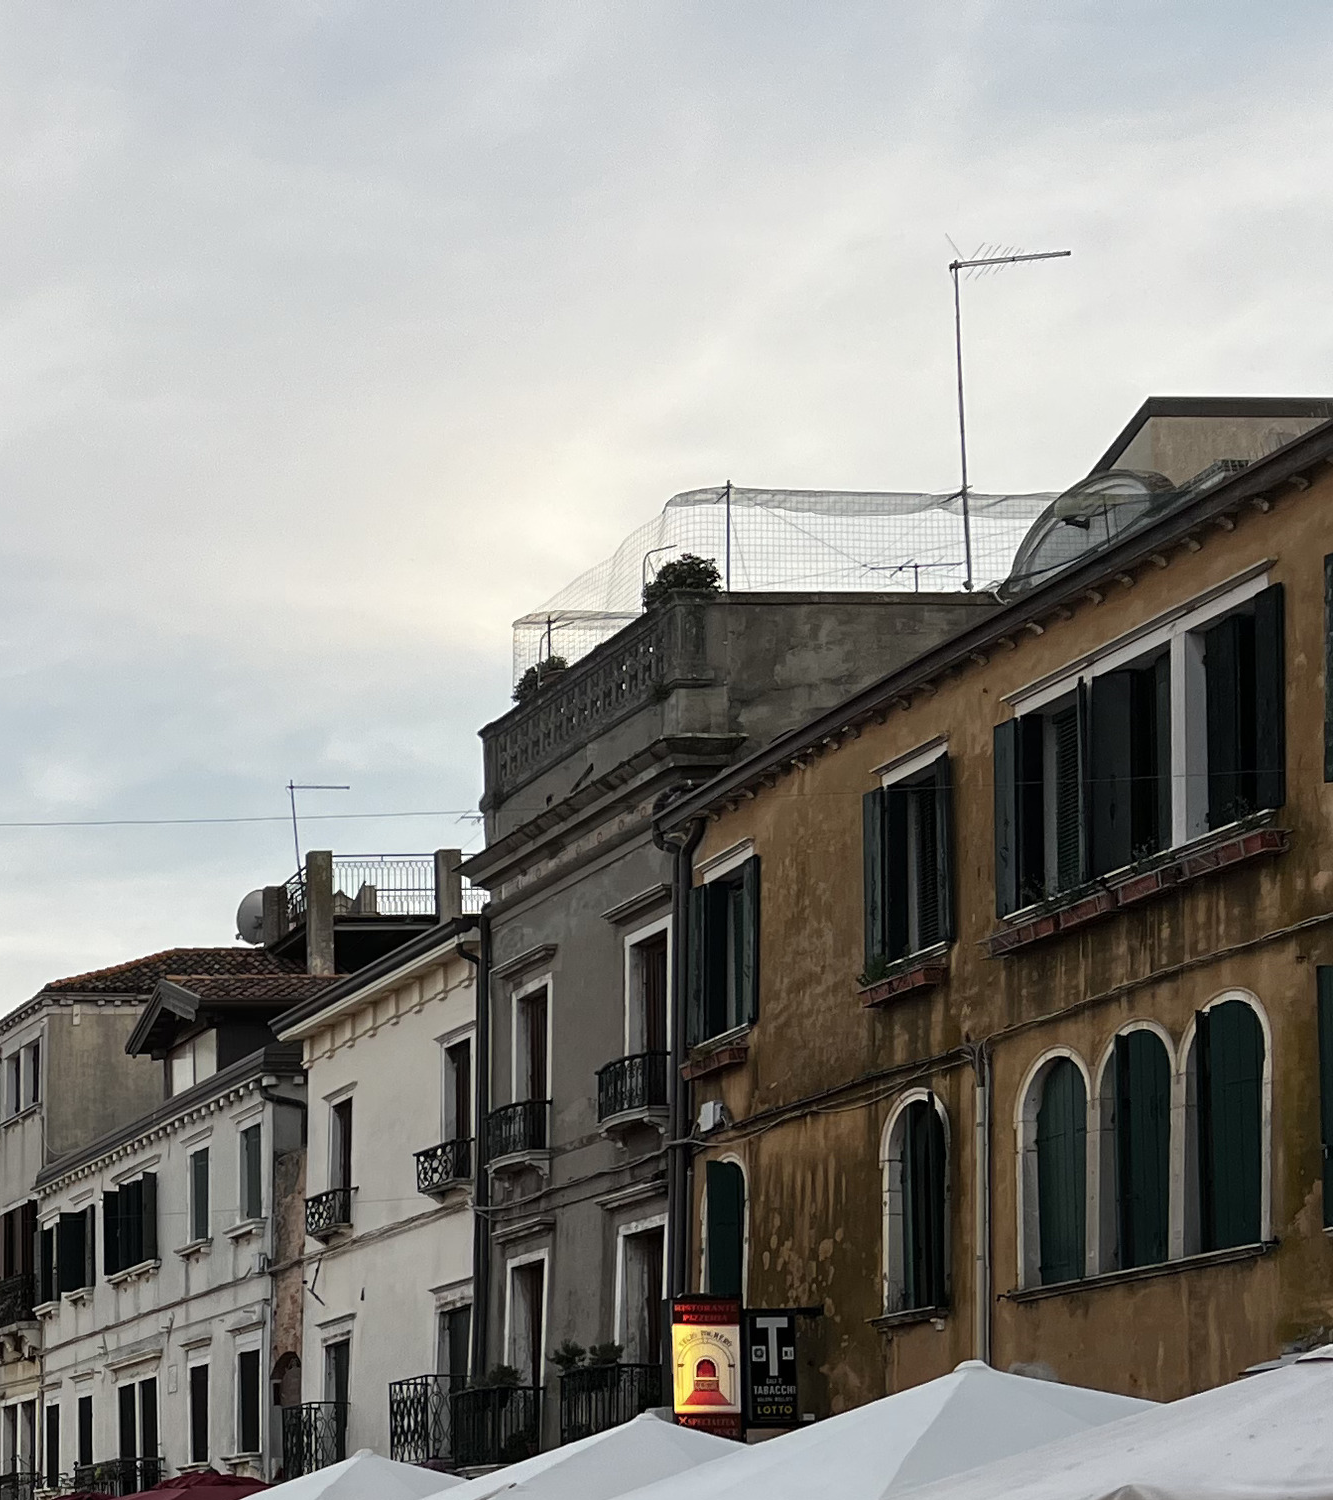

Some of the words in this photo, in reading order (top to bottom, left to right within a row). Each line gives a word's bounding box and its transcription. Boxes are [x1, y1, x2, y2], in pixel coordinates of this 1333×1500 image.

[756, 1316, 788, 1376] T
[753, 1385, 797, 1395] TABACCHI
[757, 1404, 793, 1415] LOTTO
